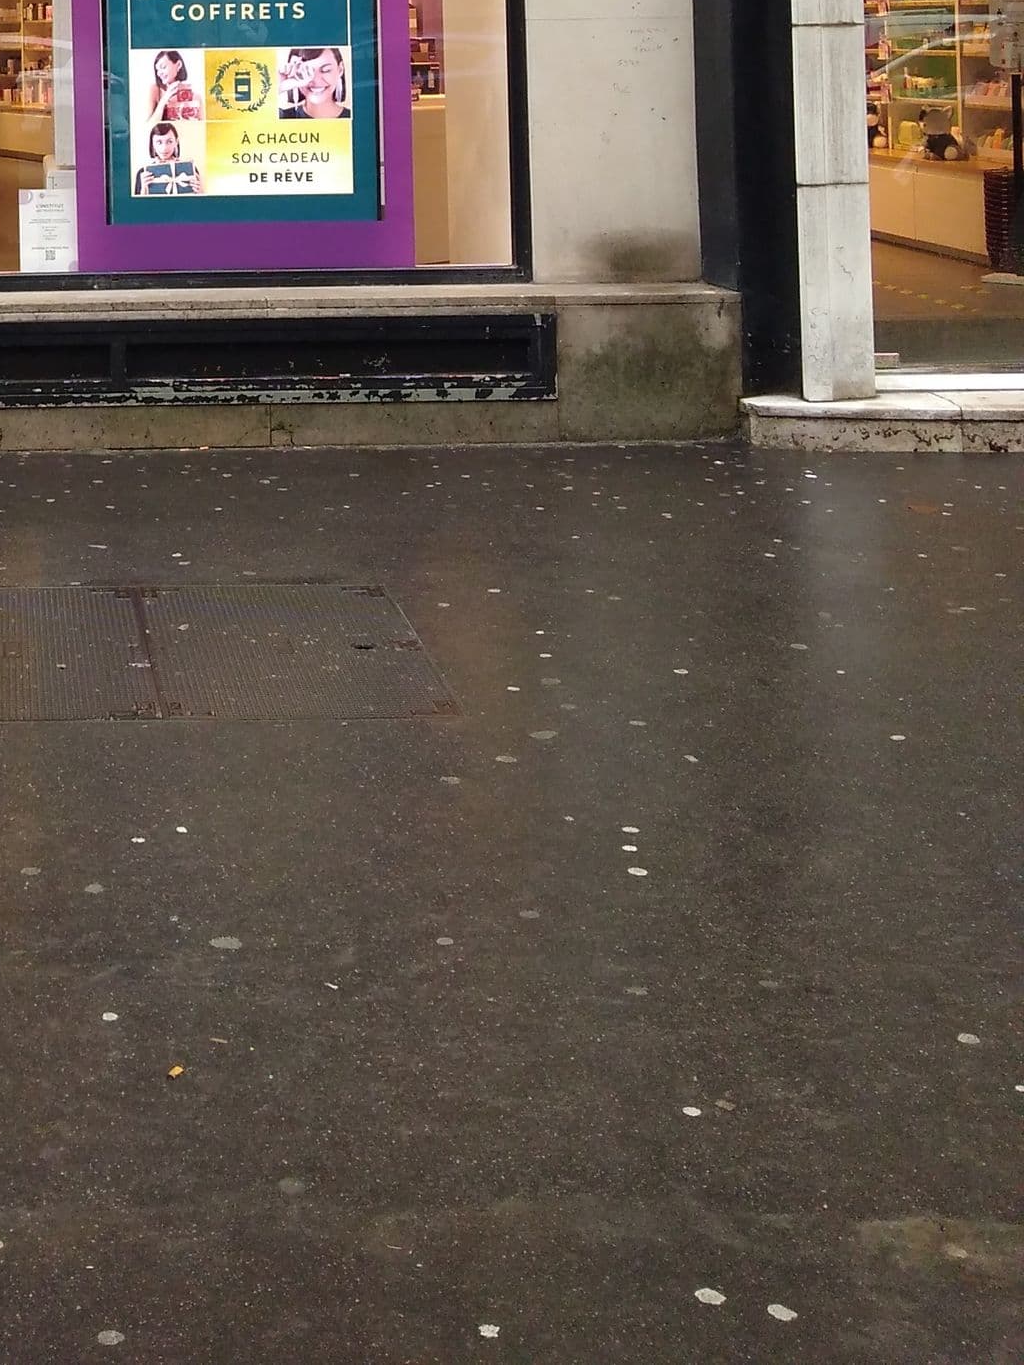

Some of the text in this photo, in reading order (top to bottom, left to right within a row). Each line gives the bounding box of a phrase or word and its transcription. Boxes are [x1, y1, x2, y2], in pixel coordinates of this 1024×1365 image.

[170, 2, 306, 21] COFFRETS
[241, 130, 320, 145] À CHACUN
[231, 151, 331, 164] SON CADEAU
[249, 169, 314, 183] DE RÊVE
